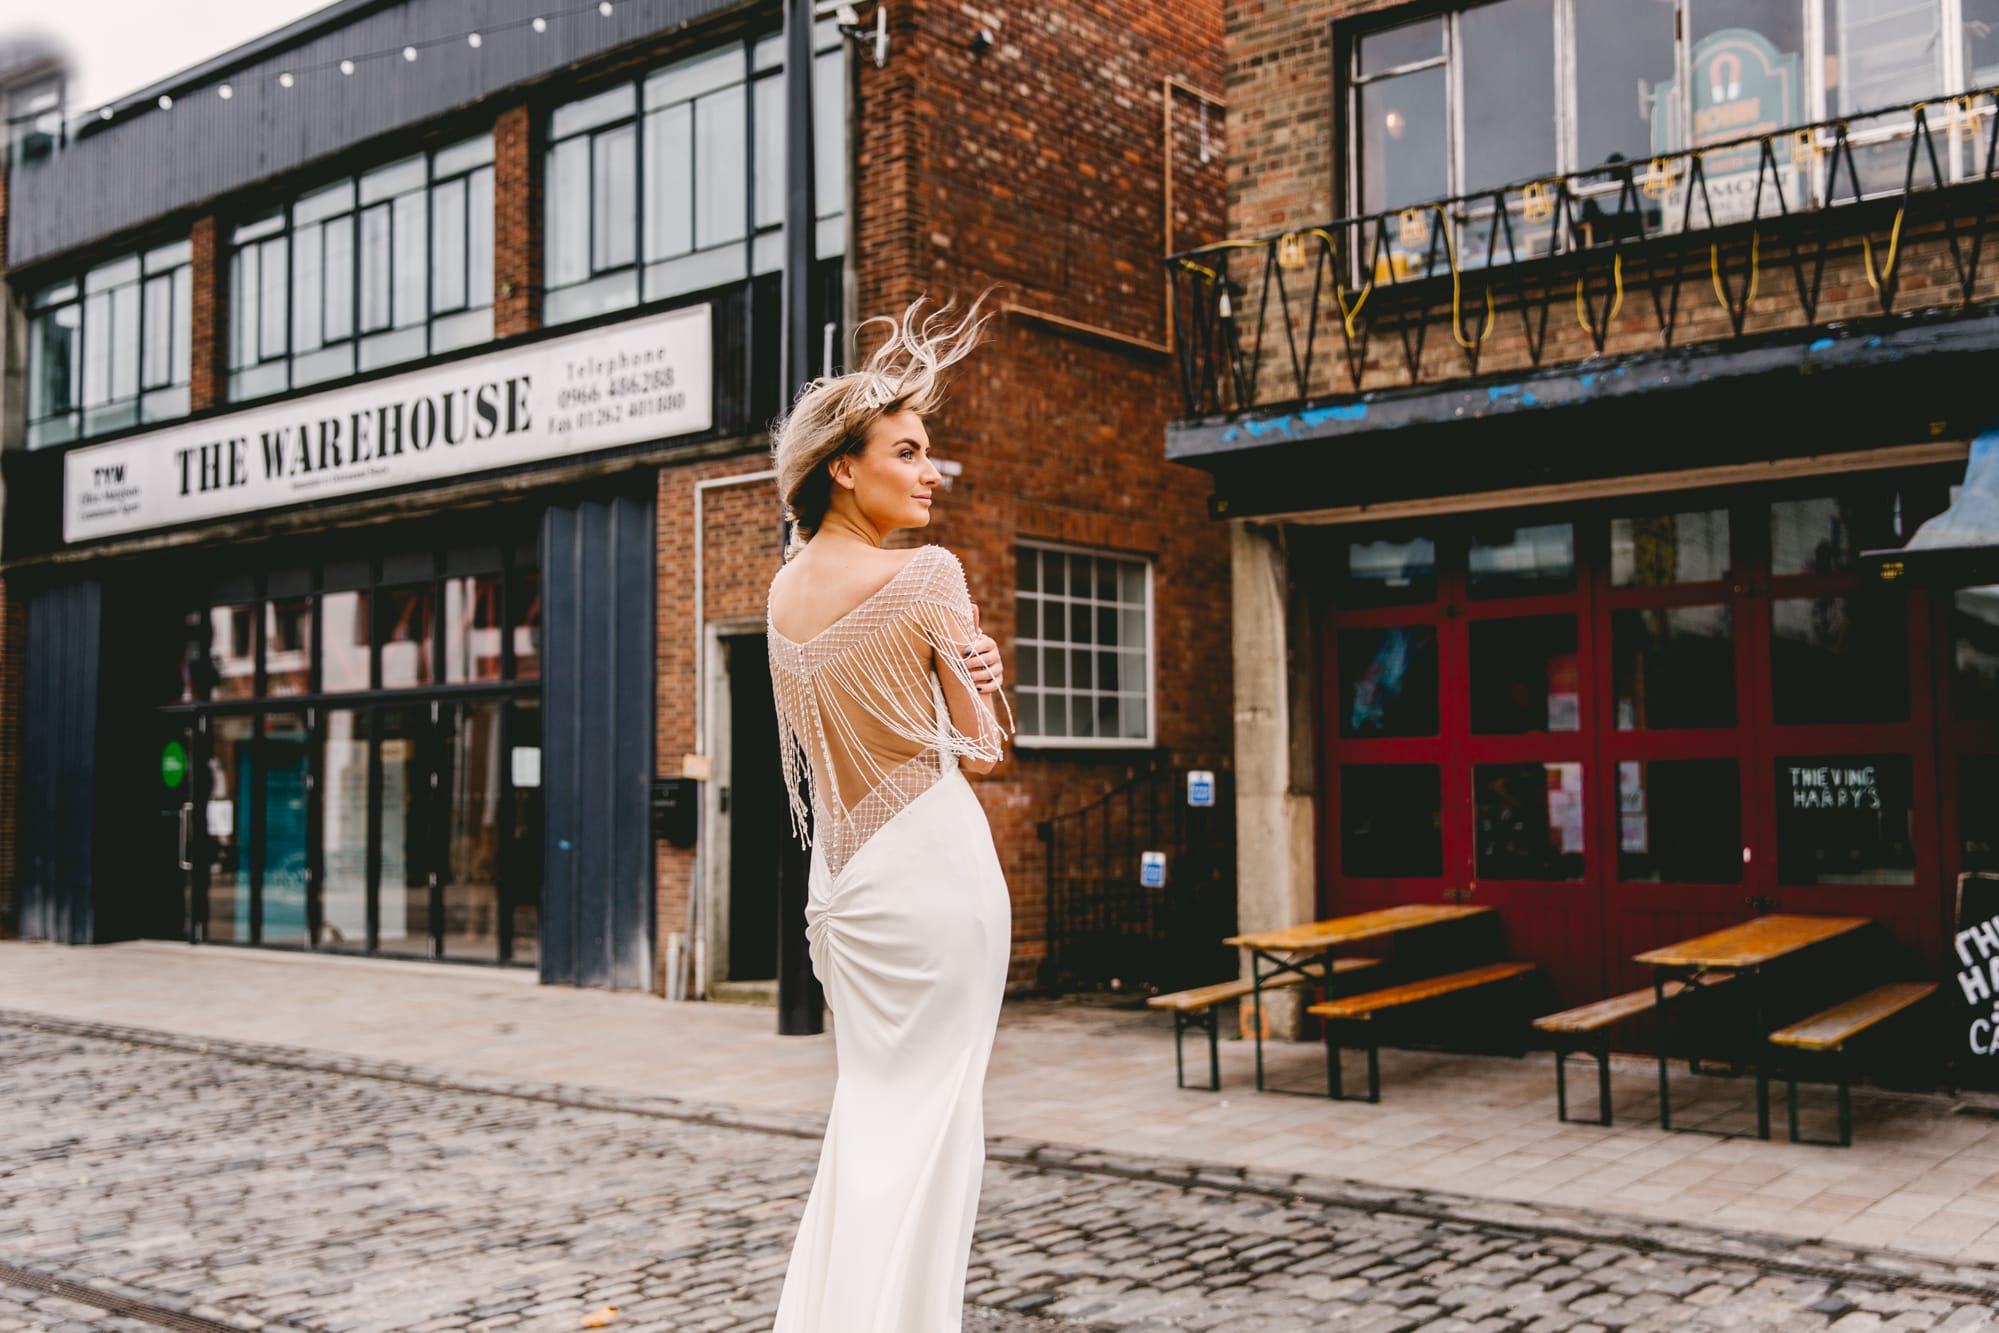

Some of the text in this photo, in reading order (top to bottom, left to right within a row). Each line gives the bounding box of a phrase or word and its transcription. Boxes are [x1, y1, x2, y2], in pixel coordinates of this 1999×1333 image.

[566, 348, 665, 381] Telephone
[174, 375, 531, 496] THE WAREHOUSE
[1788, 767, 1874, 787] THIEVING
